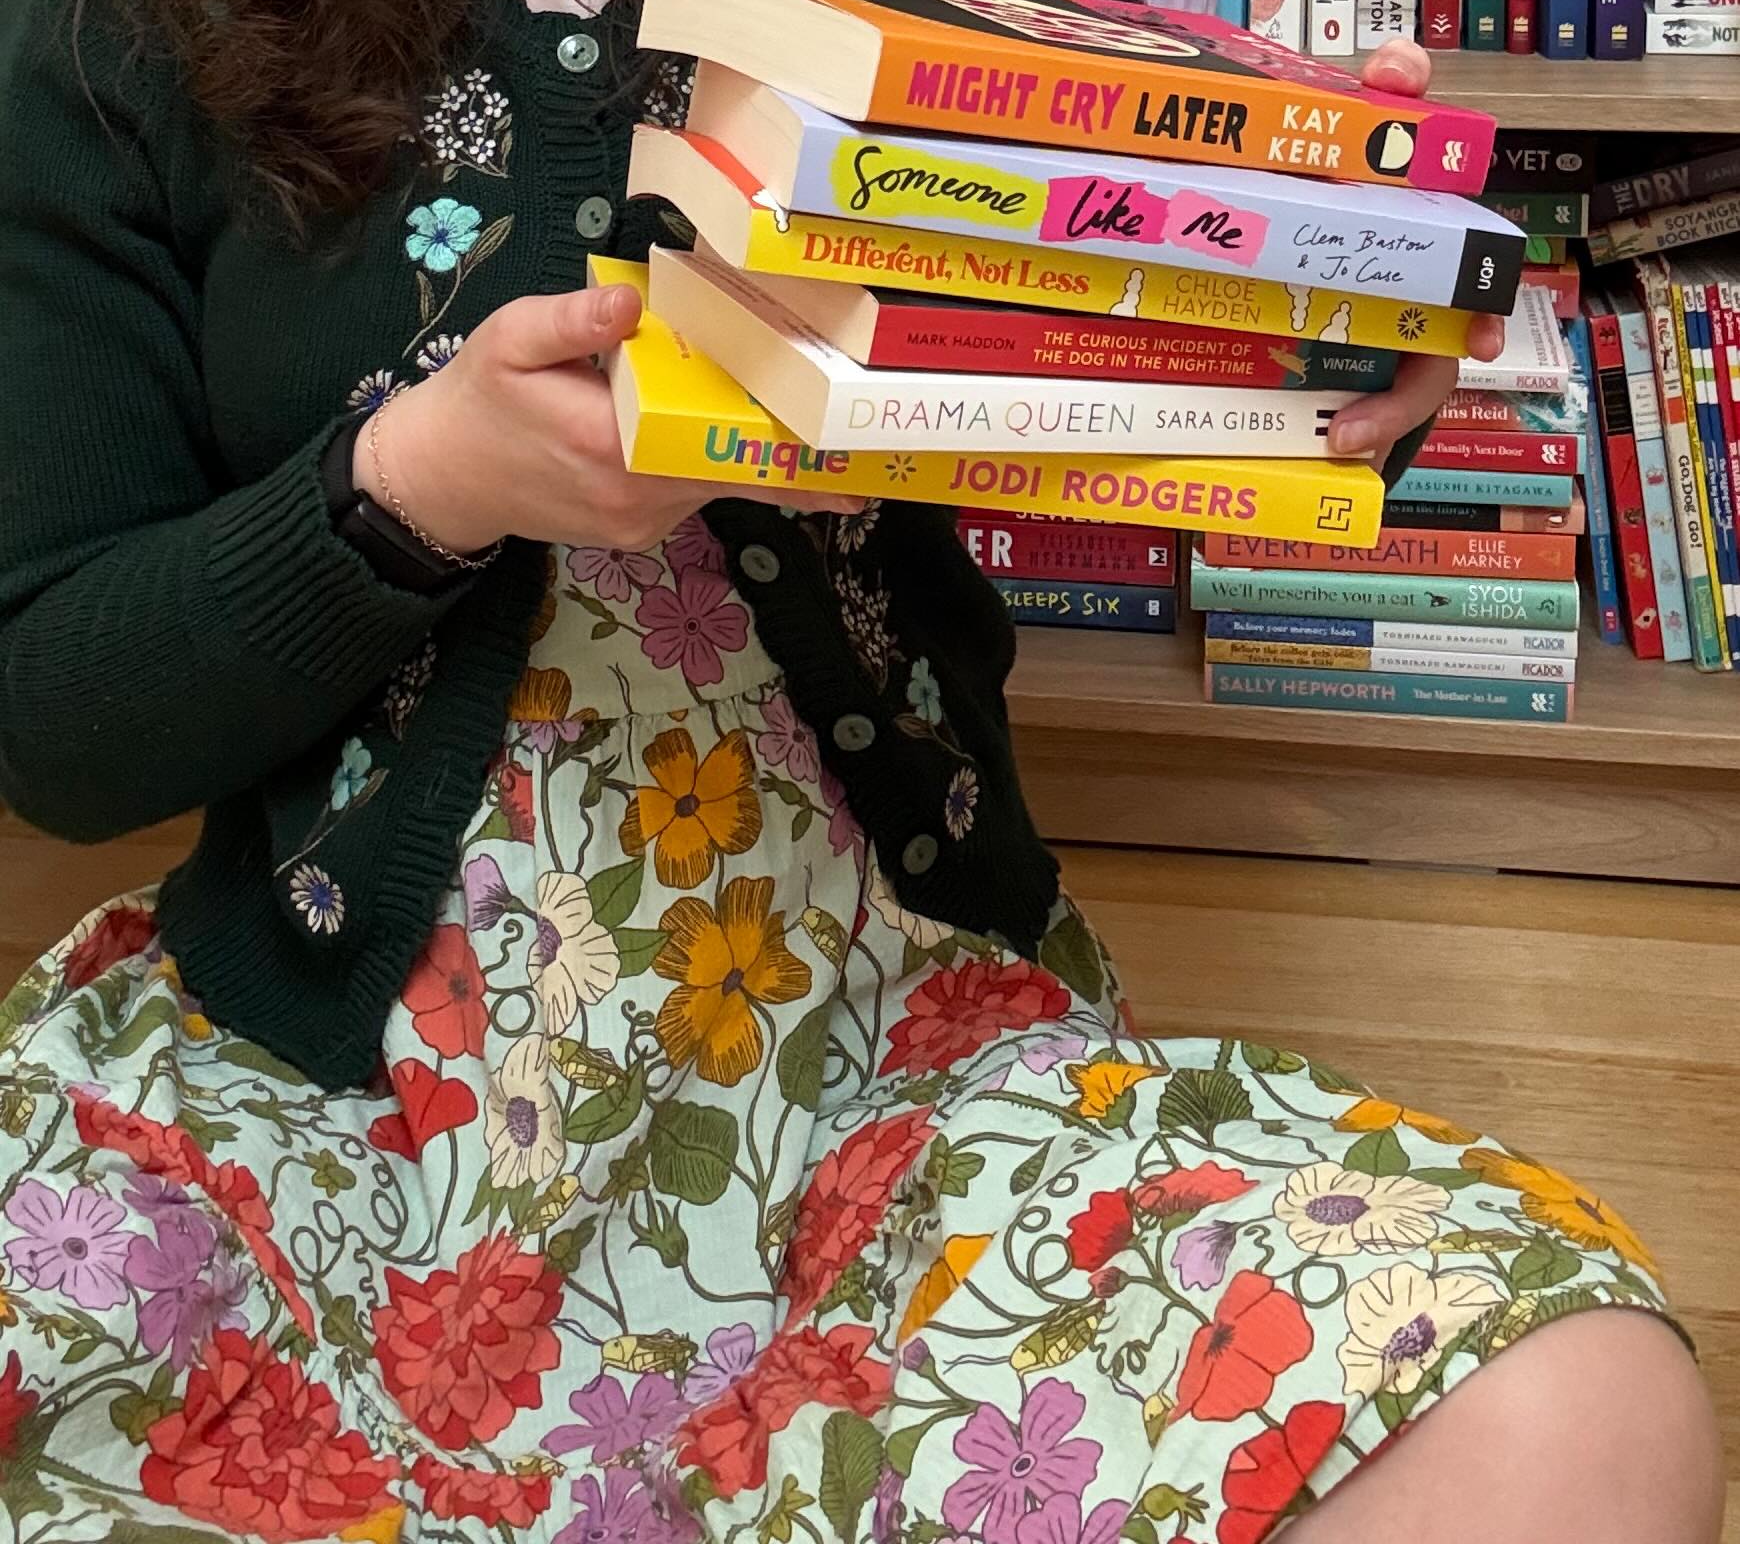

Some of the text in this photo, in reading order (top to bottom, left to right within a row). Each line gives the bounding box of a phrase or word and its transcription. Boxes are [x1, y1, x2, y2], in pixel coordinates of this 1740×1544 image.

[905, 60, 1247, 154] MIGHT CRY LATER
[1281, 104, 1343, 141] KAY
[1265, 136, 1343, 169] KERR
[1506, 148, 1551, 172] YET
[849, 145, 1029, 213] Someone
[1179, 209, 1244, 249] Me
[1633, 165, 1692, 207] DRY
[1292, 223, 1435, 254] Clem Bastow
[801, 231, 1091, 297] Different, Not Less
[1320, 254, 1352, 282] Jo
[1355, 257, 1405, 283] Case
[1476, 255, 1496, 292] UQP
[1161, 294, 1261, 326] HAYDEN
[906, 331, 1018, 352] MARK HADDON
[1042, 329, 1253, 357] THE CURIOUS INCIDENT OF
[1032, 348, 1255, 376] THE DOG IN THE NIGHT-TIME
[1321, 356, 1376, 374] VINTAGE
[847, 398, 1285, 439] DRAMA QUEEN SARA GIBBS
[1471, 405, 1509, 422] Reid
[704, 425, 850, 482] Unique
[948, 458, 1257, 521] JODI RODGERS
[1405, 479, 1553, 497] YASUSHI KITAGAWA
[1468, 539, 1507, 555] ELLIE
[1451, 554, 1523, 570] MARNEY
[1001, 590, 1120, 616] SLEEPS SIX
[1210, 582, 1252, 598] We'll
[1257, 585, 1338, 602] prescribe
[1341, 588, 1373, 607] you
[1389, 592, 1415, 607] cat
[1467, 584, 1524, 605] SYOU
[1461, 603, 1529, 621] ISHIDA
[1522, 636, 1566, 651] PICADOR
[1218, 675, 1278, 694] SALLY
[1282, 678, 1397, 701] HEPWORTH
